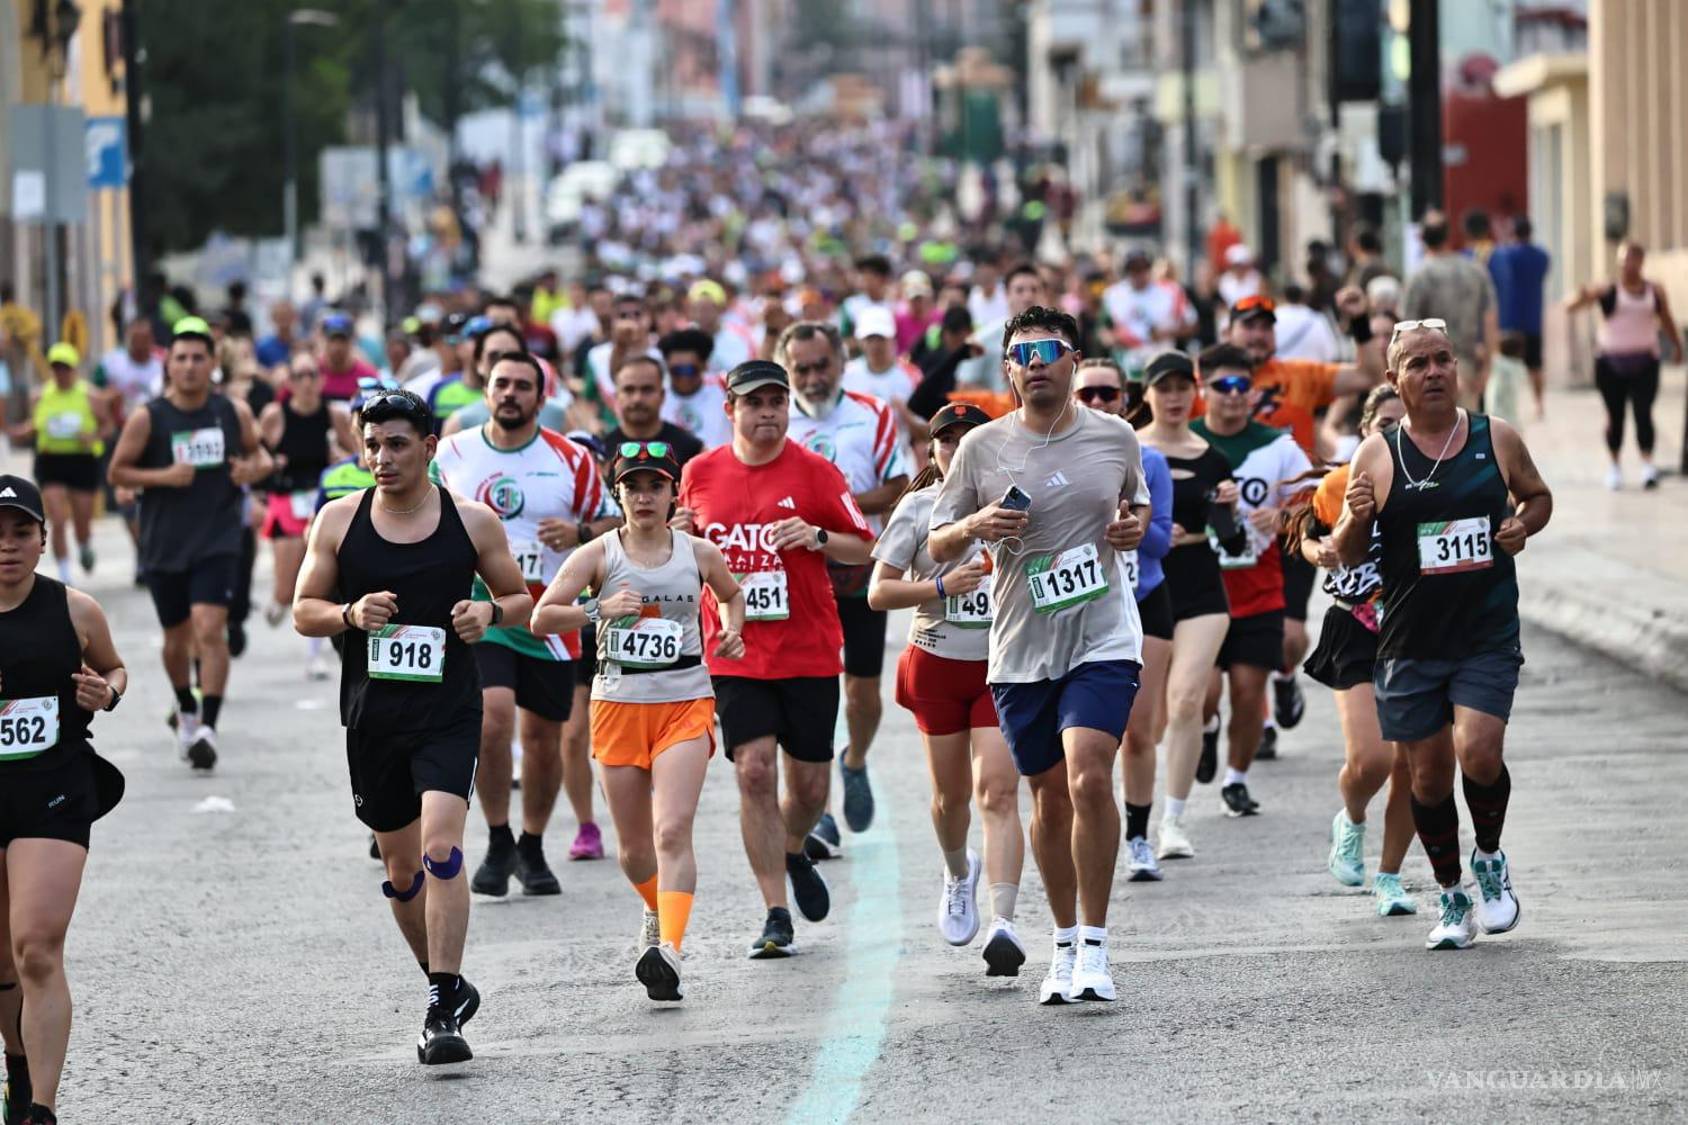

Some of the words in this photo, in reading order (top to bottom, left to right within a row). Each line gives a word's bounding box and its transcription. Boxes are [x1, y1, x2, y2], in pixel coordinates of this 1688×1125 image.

[1437, 532, 1488, 561] 3115
[1047, 559, 1097, 597] 1317
[641, 594, 694, 603] GALAS
[746, 587, 781, 609] 451
[962, 592, 992, 616] 49
[389, 641, 432, 669] 918
[623, 631, 676, 659] 4736
[0, 716, 46, 746] 562
